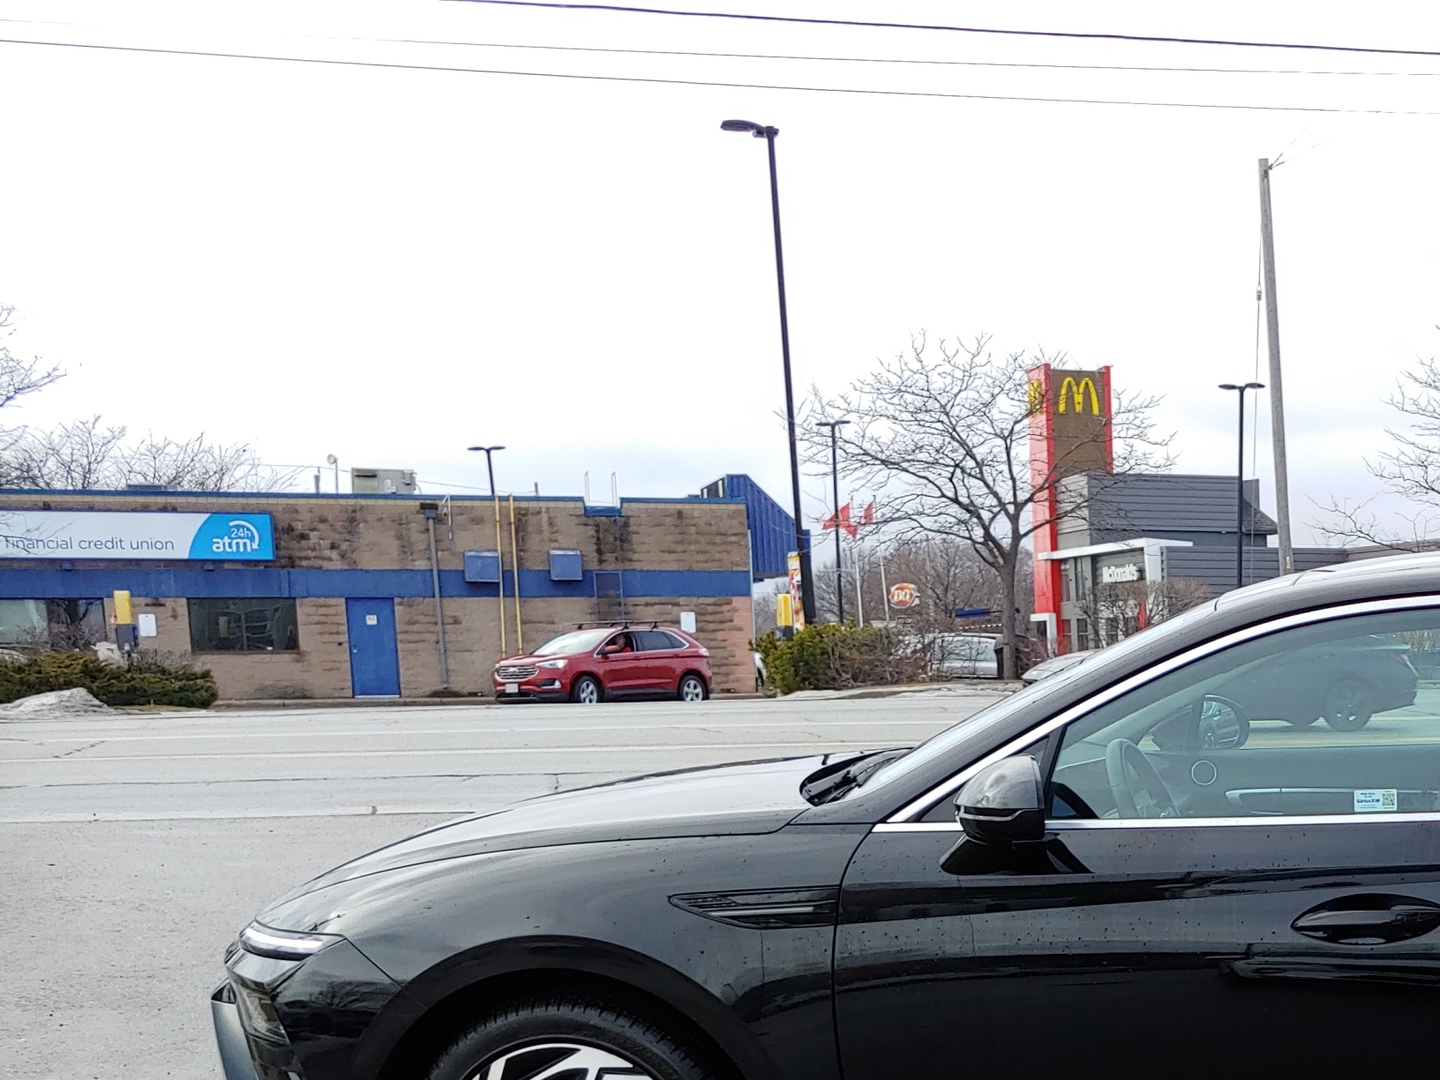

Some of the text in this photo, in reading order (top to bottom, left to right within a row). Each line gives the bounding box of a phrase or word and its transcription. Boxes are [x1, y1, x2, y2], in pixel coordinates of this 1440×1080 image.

[230, 527, 251, 538] 24h
[5, 536, 175, 551] financial credit union
[212, 536, 253, 553] atm
